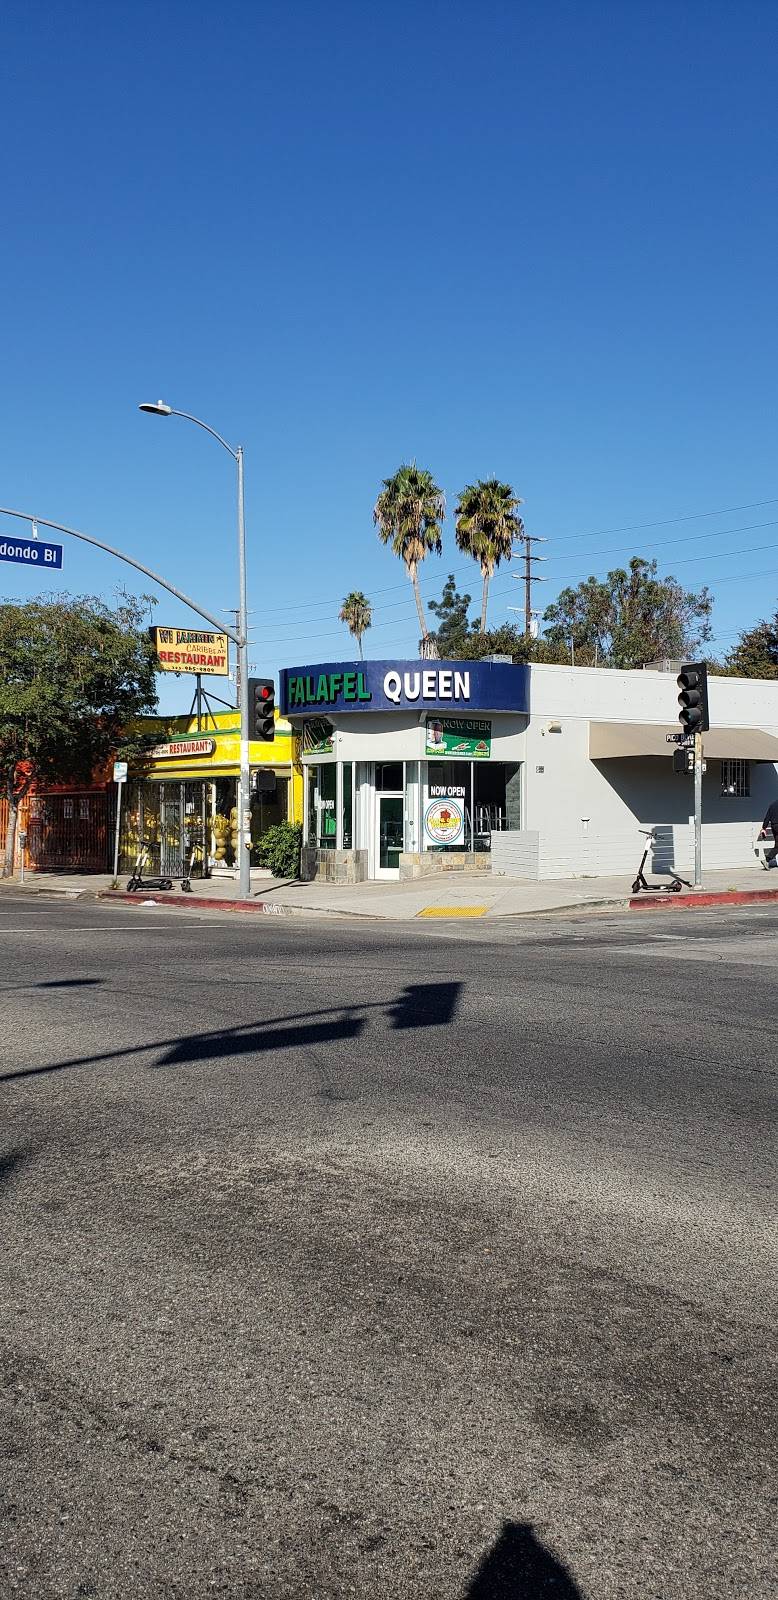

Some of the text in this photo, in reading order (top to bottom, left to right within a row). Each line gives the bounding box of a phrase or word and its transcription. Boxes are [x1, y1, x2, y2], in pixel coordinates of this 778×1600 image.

[44, 548, 57, 562] Bl
[159, 651, 226, 667] RESTAURANT
[288, 671, 470, 704] FALAFEL QUEEN
[443, 720, 490, 731] NOW OPEN
[169, 741, 208, 754] RESTAURANT
[430, 786, 466, 797] NOW OPEN
